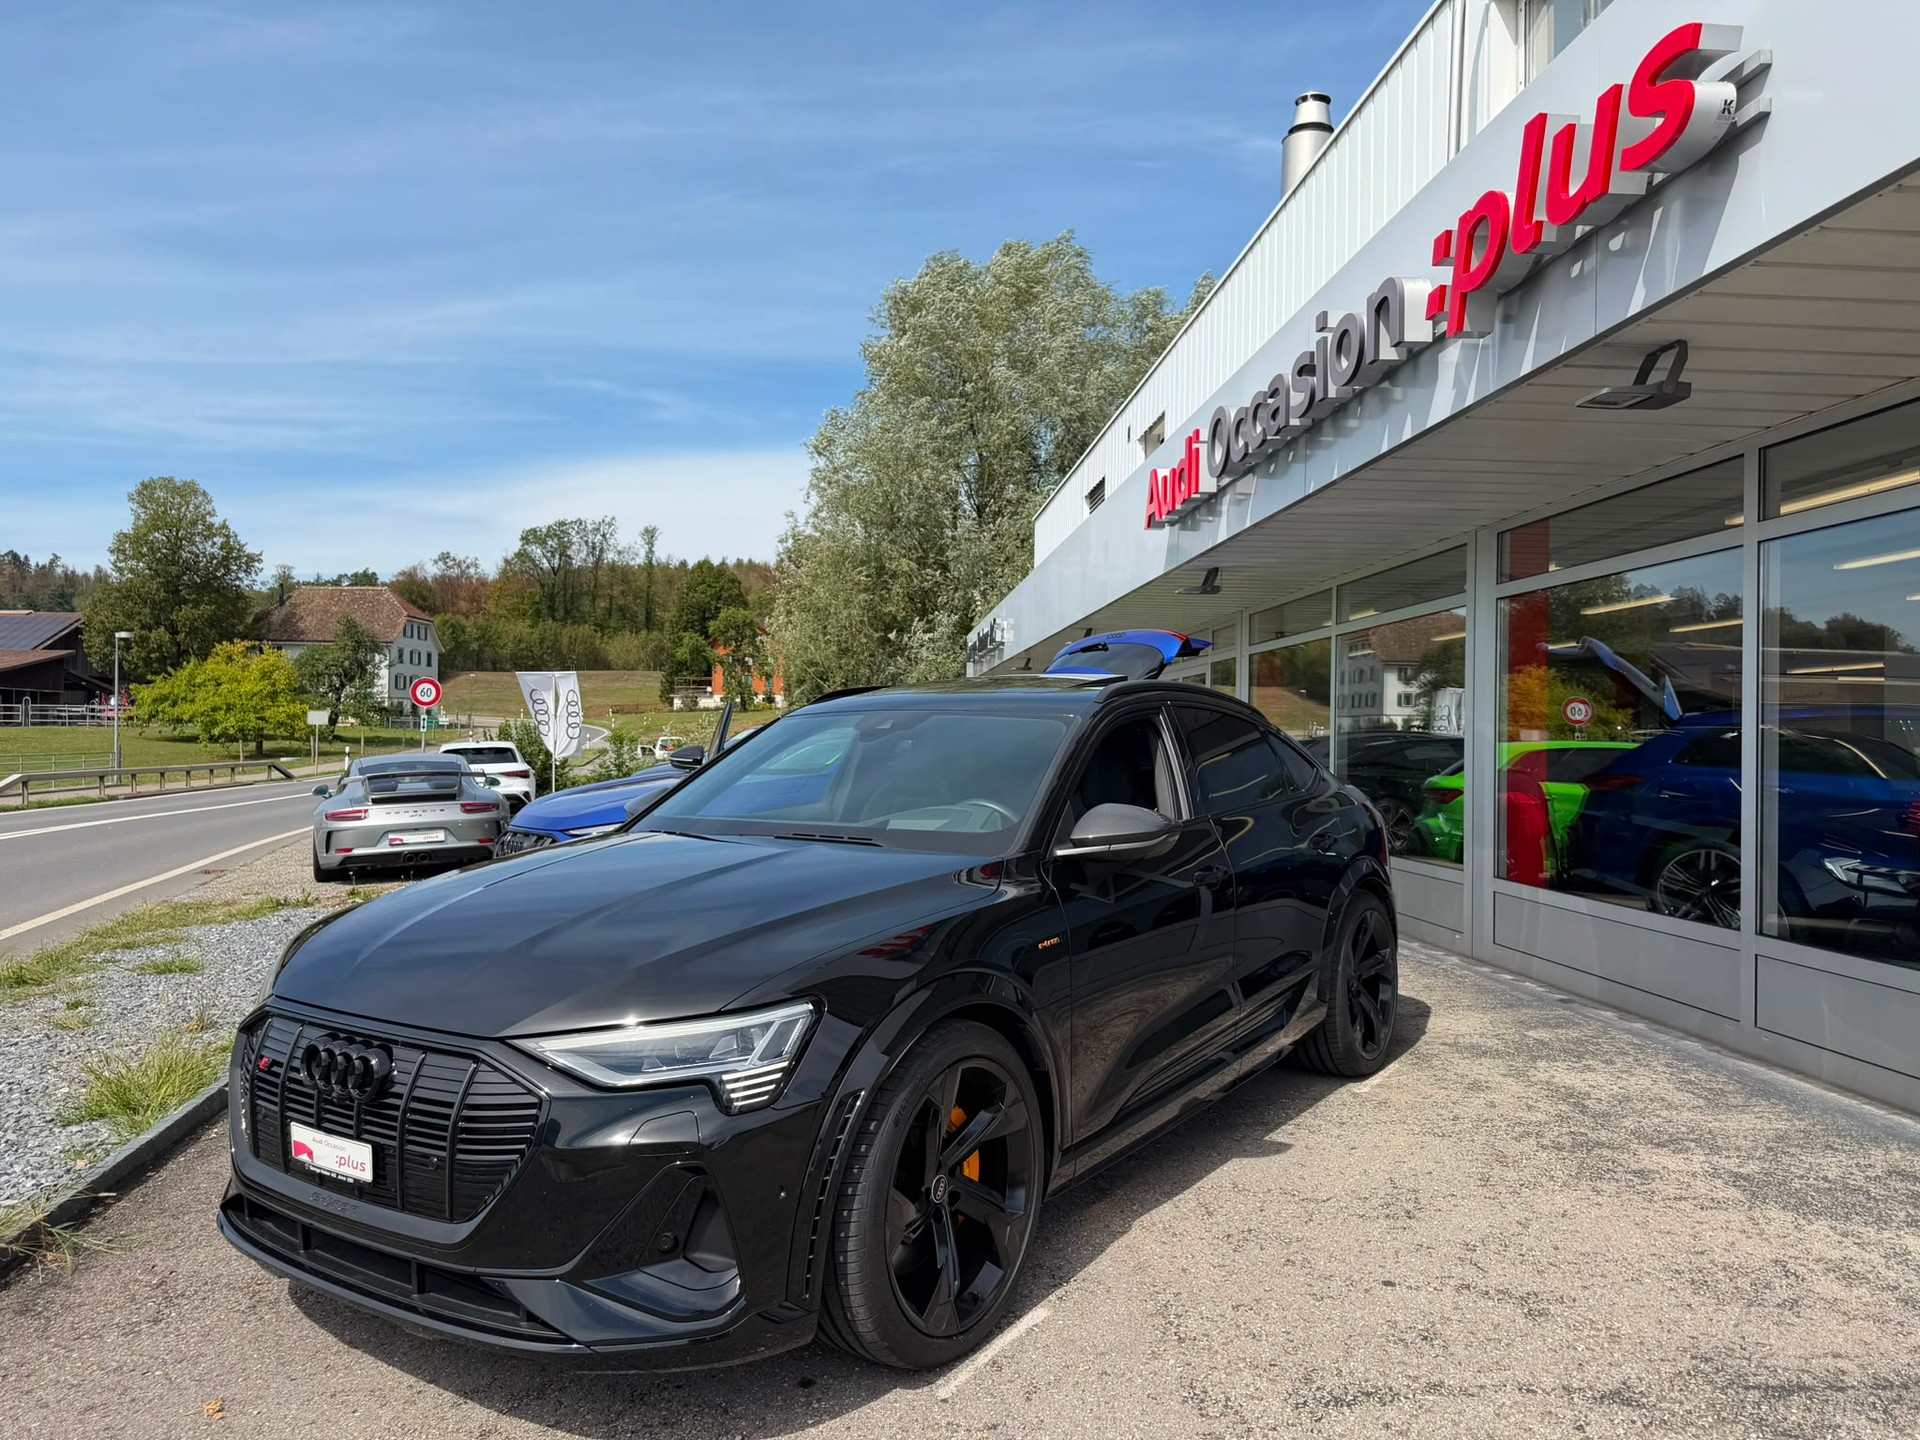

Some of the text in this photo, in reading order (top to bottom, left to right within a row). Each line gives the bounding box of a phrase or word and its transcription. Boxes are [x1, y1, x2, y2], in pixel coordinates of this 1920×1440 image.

[1145, 22, 1704, 530] Audi Occasion :plus
[420, 687, 432, 698] 60
[312, 1136, 347, 1152] Audi Occasion
[335, 1154, 367, 1173] :plus
